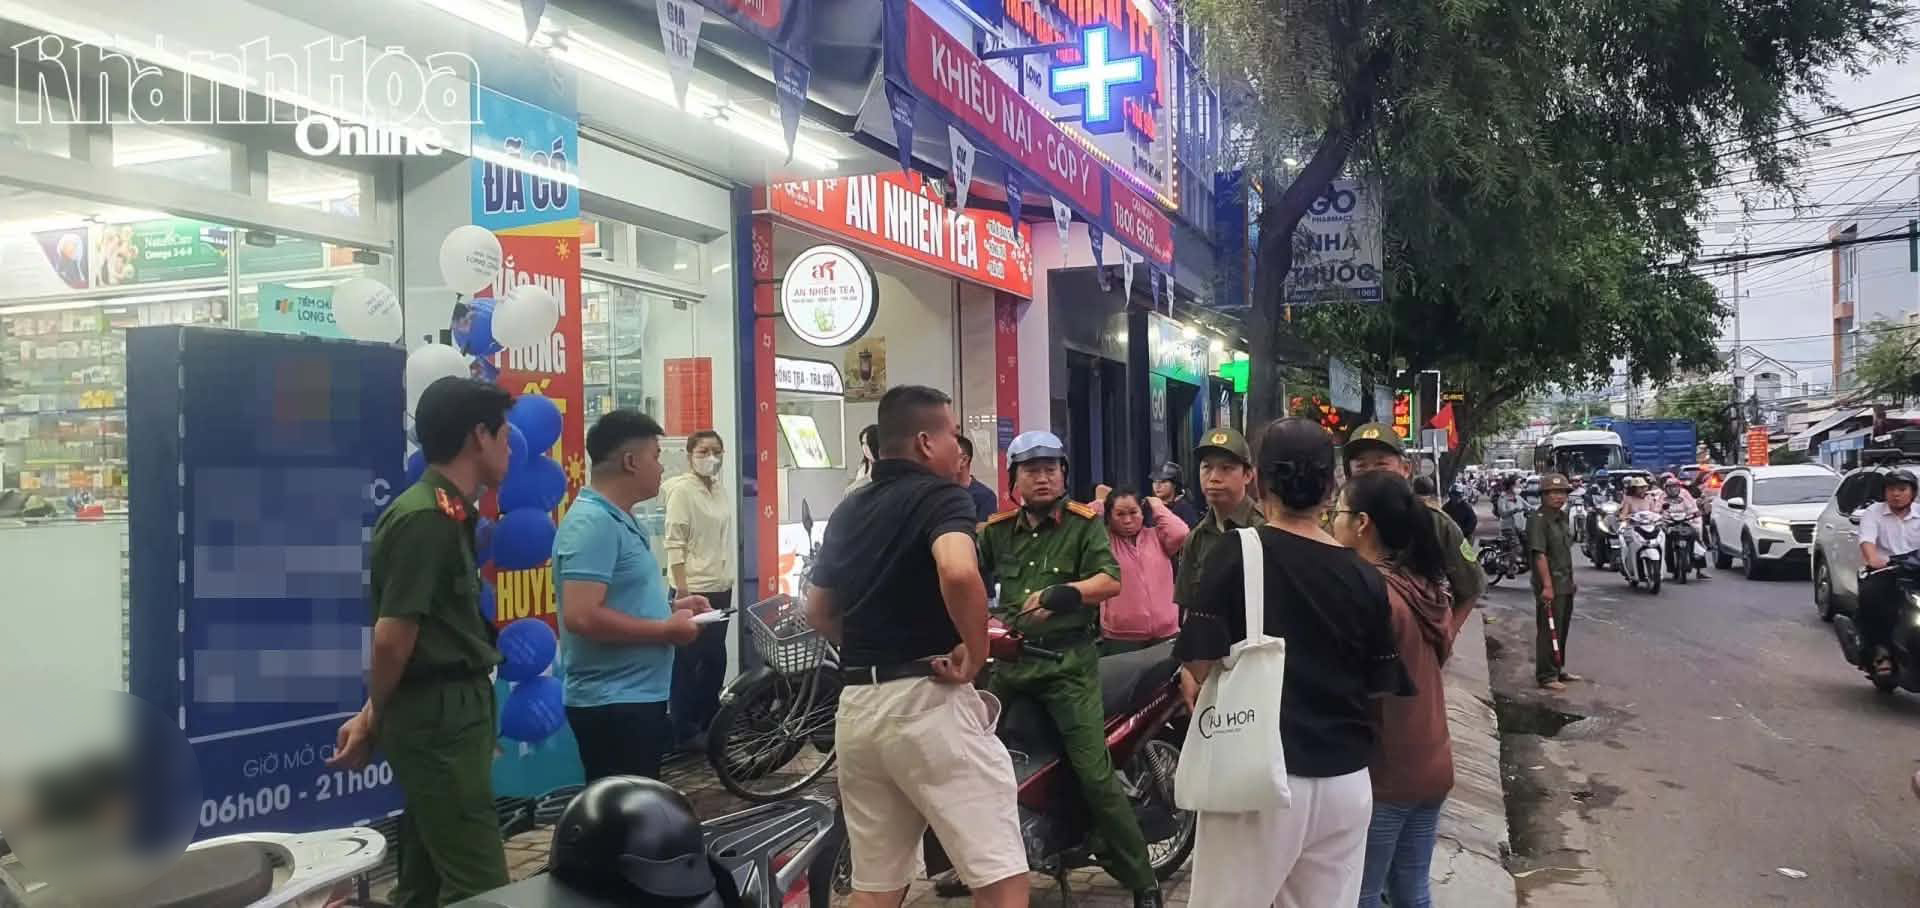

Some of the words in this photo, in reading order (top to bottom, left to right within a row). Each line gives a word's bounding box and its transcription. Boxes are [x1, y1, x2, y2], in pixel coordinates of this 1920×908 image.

[931, 33, 996, 124] KHIẾU
[1002, 94, 1032, 157] NẠI
[1047, 133, 1077, 185] GÓP
[1079, 156, 1090, 197] Ý
[482, 137, 527, 214] ĐÃ
[529, 136, 569, 211] CÓ
[1114, 201, 1135, 238] 1800
[1309, 189, 1356, 216] GO
[845, 174, 878, 235] AN
[883, 180, 944, 259] NHIÊN
[948, 208, 979, 271] TEA
[794, 288, 806, 297] AN
[839, 286, 856, 295] TEA
[298, 310, 325, 322] LONG
[1152, 388, 1165, 421] GO
[1226, 708, 1255, 727] HOA
[243, 751, 279, 778] GIỜ
[283, 743, 315, 769] MỞ
[200, 783, 291, 827] 06h00
[315, 759, 394, 801] 21h00
